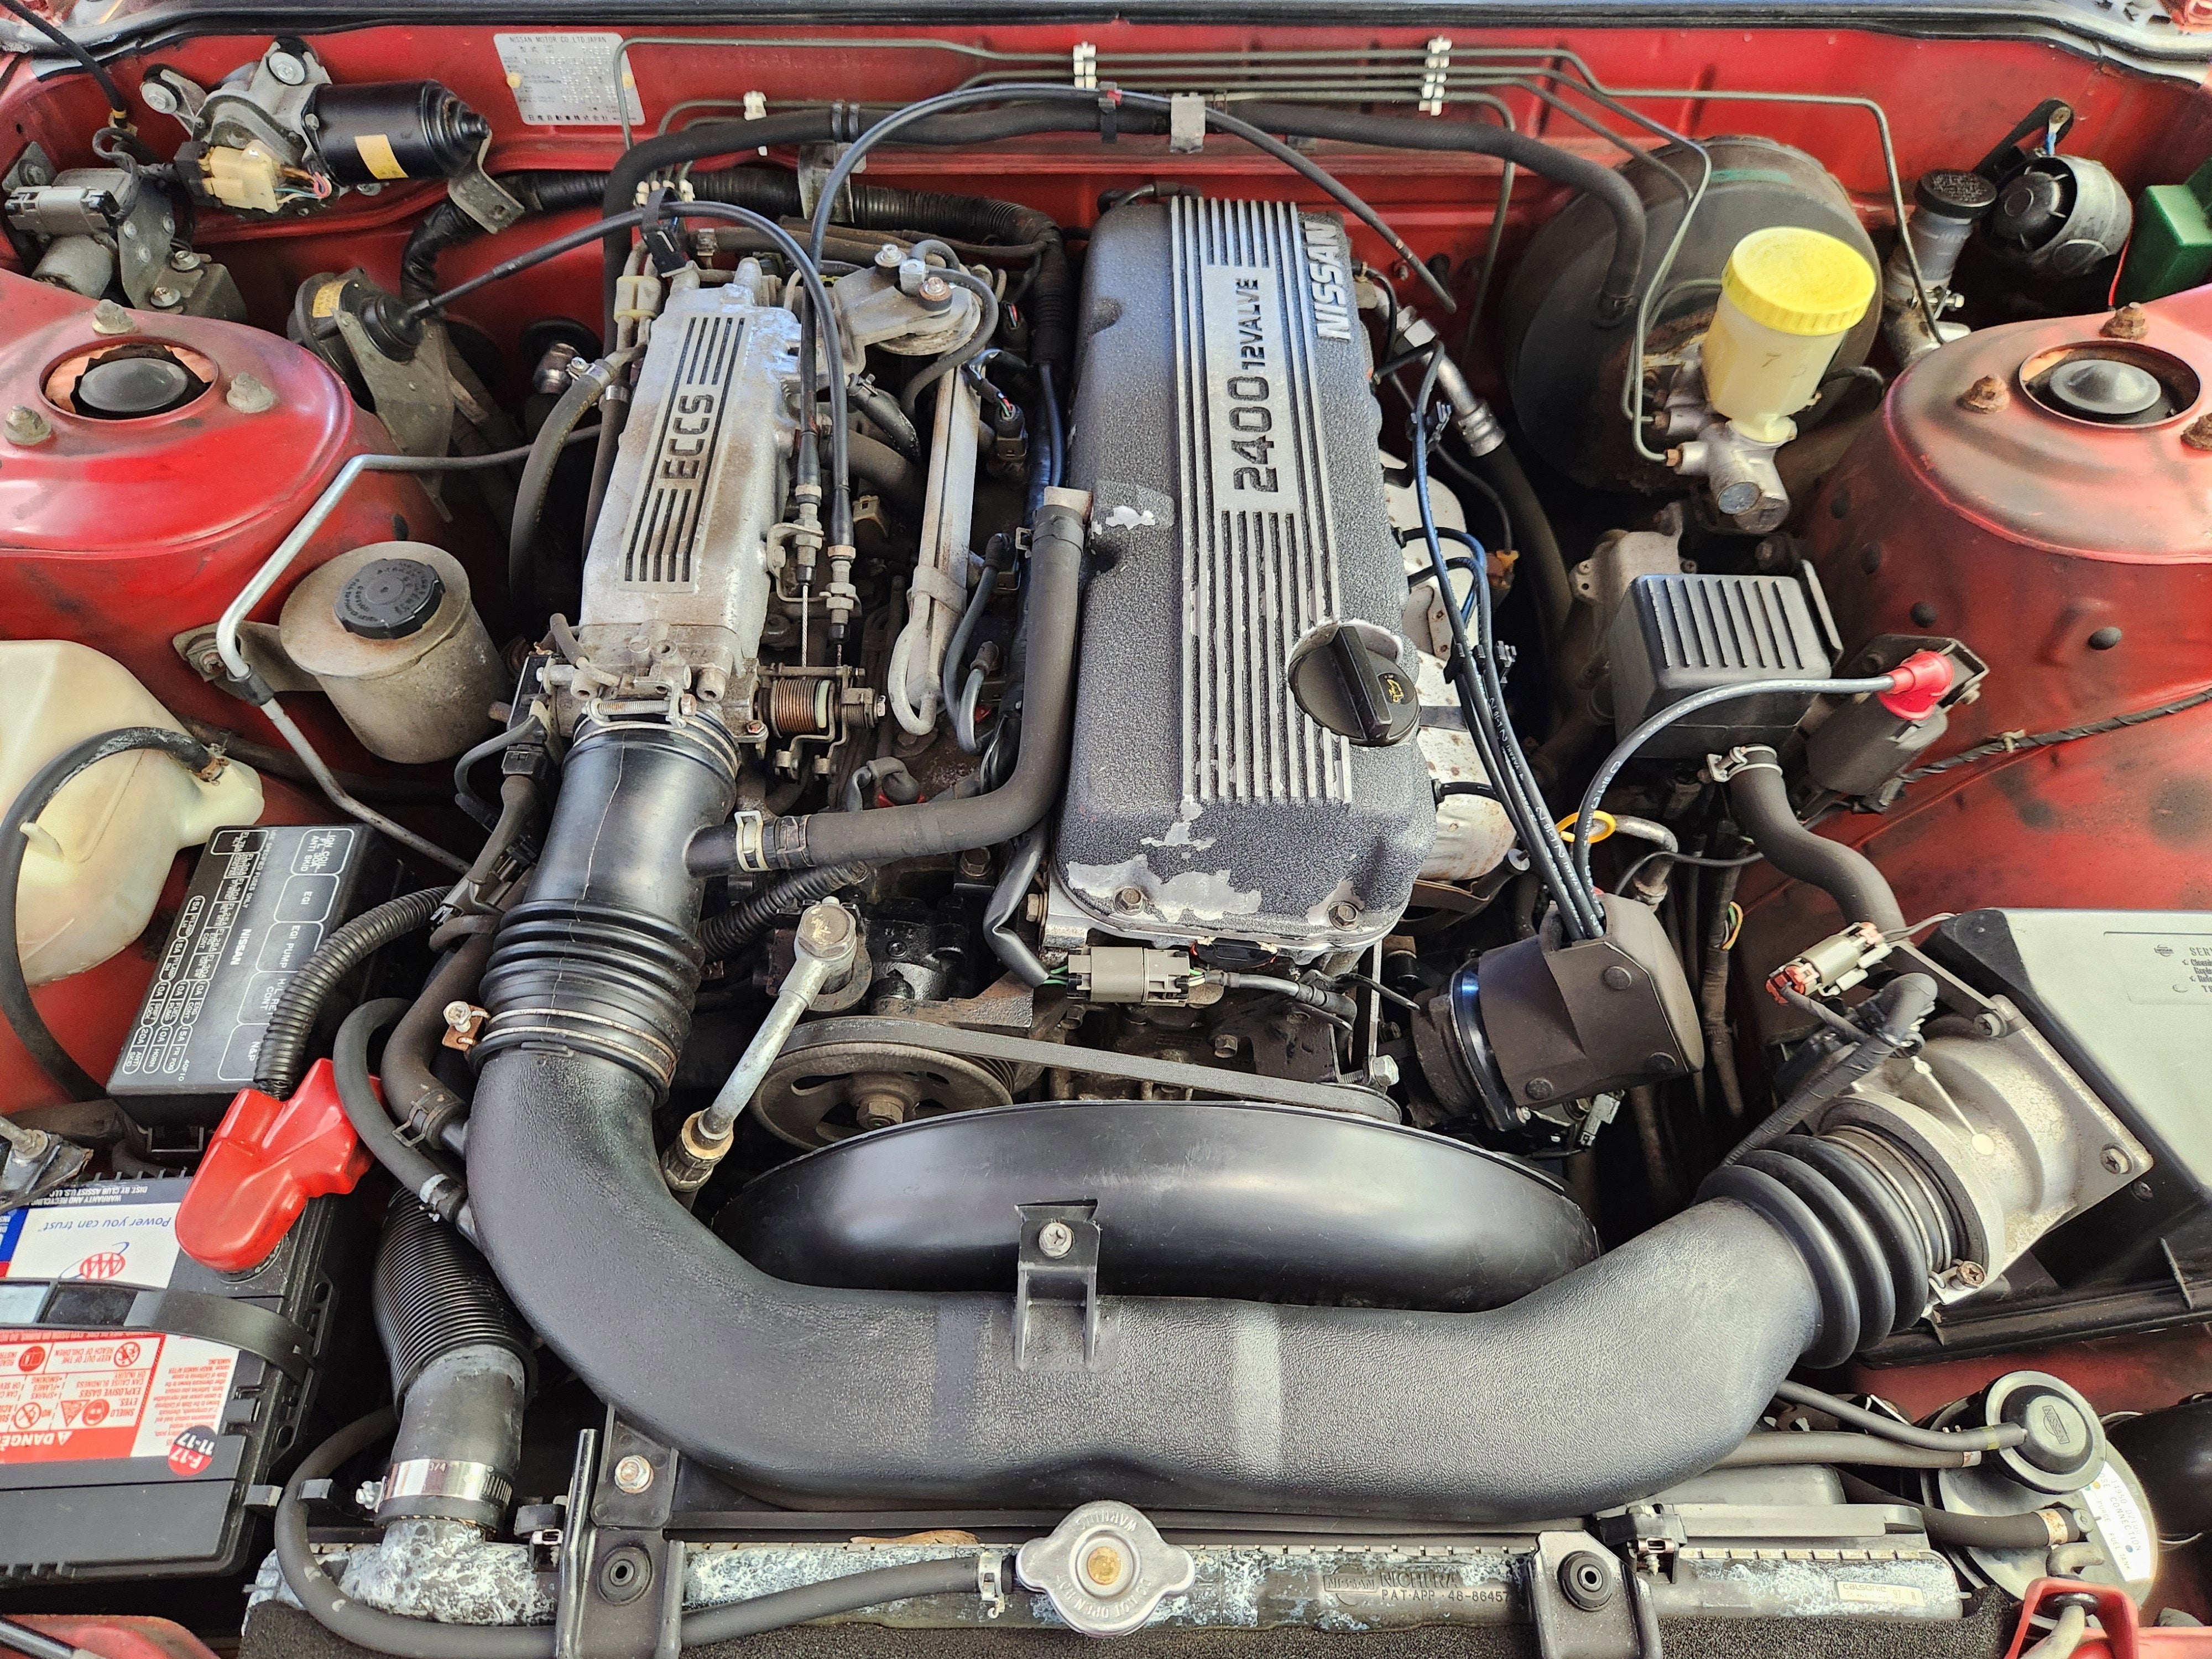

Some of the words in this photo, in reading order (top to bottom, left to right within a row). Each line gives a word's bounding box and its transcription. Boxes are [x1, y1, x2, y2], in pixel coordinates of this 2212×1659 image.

[1303, 221, 1351, 341] NISSAN
[1234, 278, 1266, 371] 12VALVE
[660, 394, 714, 479] ECCS
[1227, 375, 1278, 493] 2400
[307, 836, 320, 852] ANTI
[325, 835, 336, 847] IGN
[301, 855, 312, 872] SKID
[310, 853, 321, 867] 30A
[317, 851, 330, 869] COIL
[248, 872, 260, 891] FUSES
[190, 898, 201, 911] 15A
[241, 893, 253, 910] ONLY
[300, 891, 312, 905] EGI
[290, 925, 301, 939] EGI
[173, 940, 185, 953] 15A
[199, 932, 209, 949] CONT
[230, 928, 252, 965] NISSAN
[279, 943, 294, 968] PUMP
[155, 983, 167, 997] 10A
[175, 982, 186, 996] 10A
[195, 982, 206, 995] 10A
[260, 986, 274, 1010] CONT
[144, 1003, 155, 1020] LOCK
[164, 1003, 175, 1021] PUMP
[170, 1002, 180, 1020] FUEL
[184, 1002, 194, 1019] CONT
[191, 1001, 201, 1015] ENG
[137, 1029, 148, 1044] 20A
[157, 1027, 169, 1042] 10A
[178, 1027, 189, 1041] 15A
[149, 1048, 160, 1067] HORN
[173, 1047, 181, 1055] FR
[248, 1041, 260, 1061] N&P
[126, 1052, 135, 1066] SKID
[132, 1052, 142, 1066] ANTI
[168, 1057, 177, 1070] FOG
[77, 1188, 101, 1196] ASSIST
[101, 1187, 120, 1195] CLUB
[84, 1194, 122, 1204] WARRANTY
[77, 1220, 99, 1229] can
[102, 1217, 129, 1229] you
[129, 1217, 171, 1228] Power
[81, 1253, 124, 1280] AAA
[79, 1389, 102, 1398] GASES
[104, 1387, 142, 1396] EXPLOSIVE
[119, 1398, 138, 1406] EYES.
[110, 1408, 134, 1417] SHIELD
[2044, 1407, 2069, 1443] NISSAN
[177, 1432, 215, 1455] 11-17
[2096, 1500, 2111, 1523] PURGE
[1074, 1509, 1138, 1532] WARNING
[2110, 1496, 2141, 1552] CONNECTION
[2108, 1532, 2120, 1551] FUEL
[2119, 1553, 2131, 1571] TANK
[1327, 1577, 1375, 1591] NISSAN
